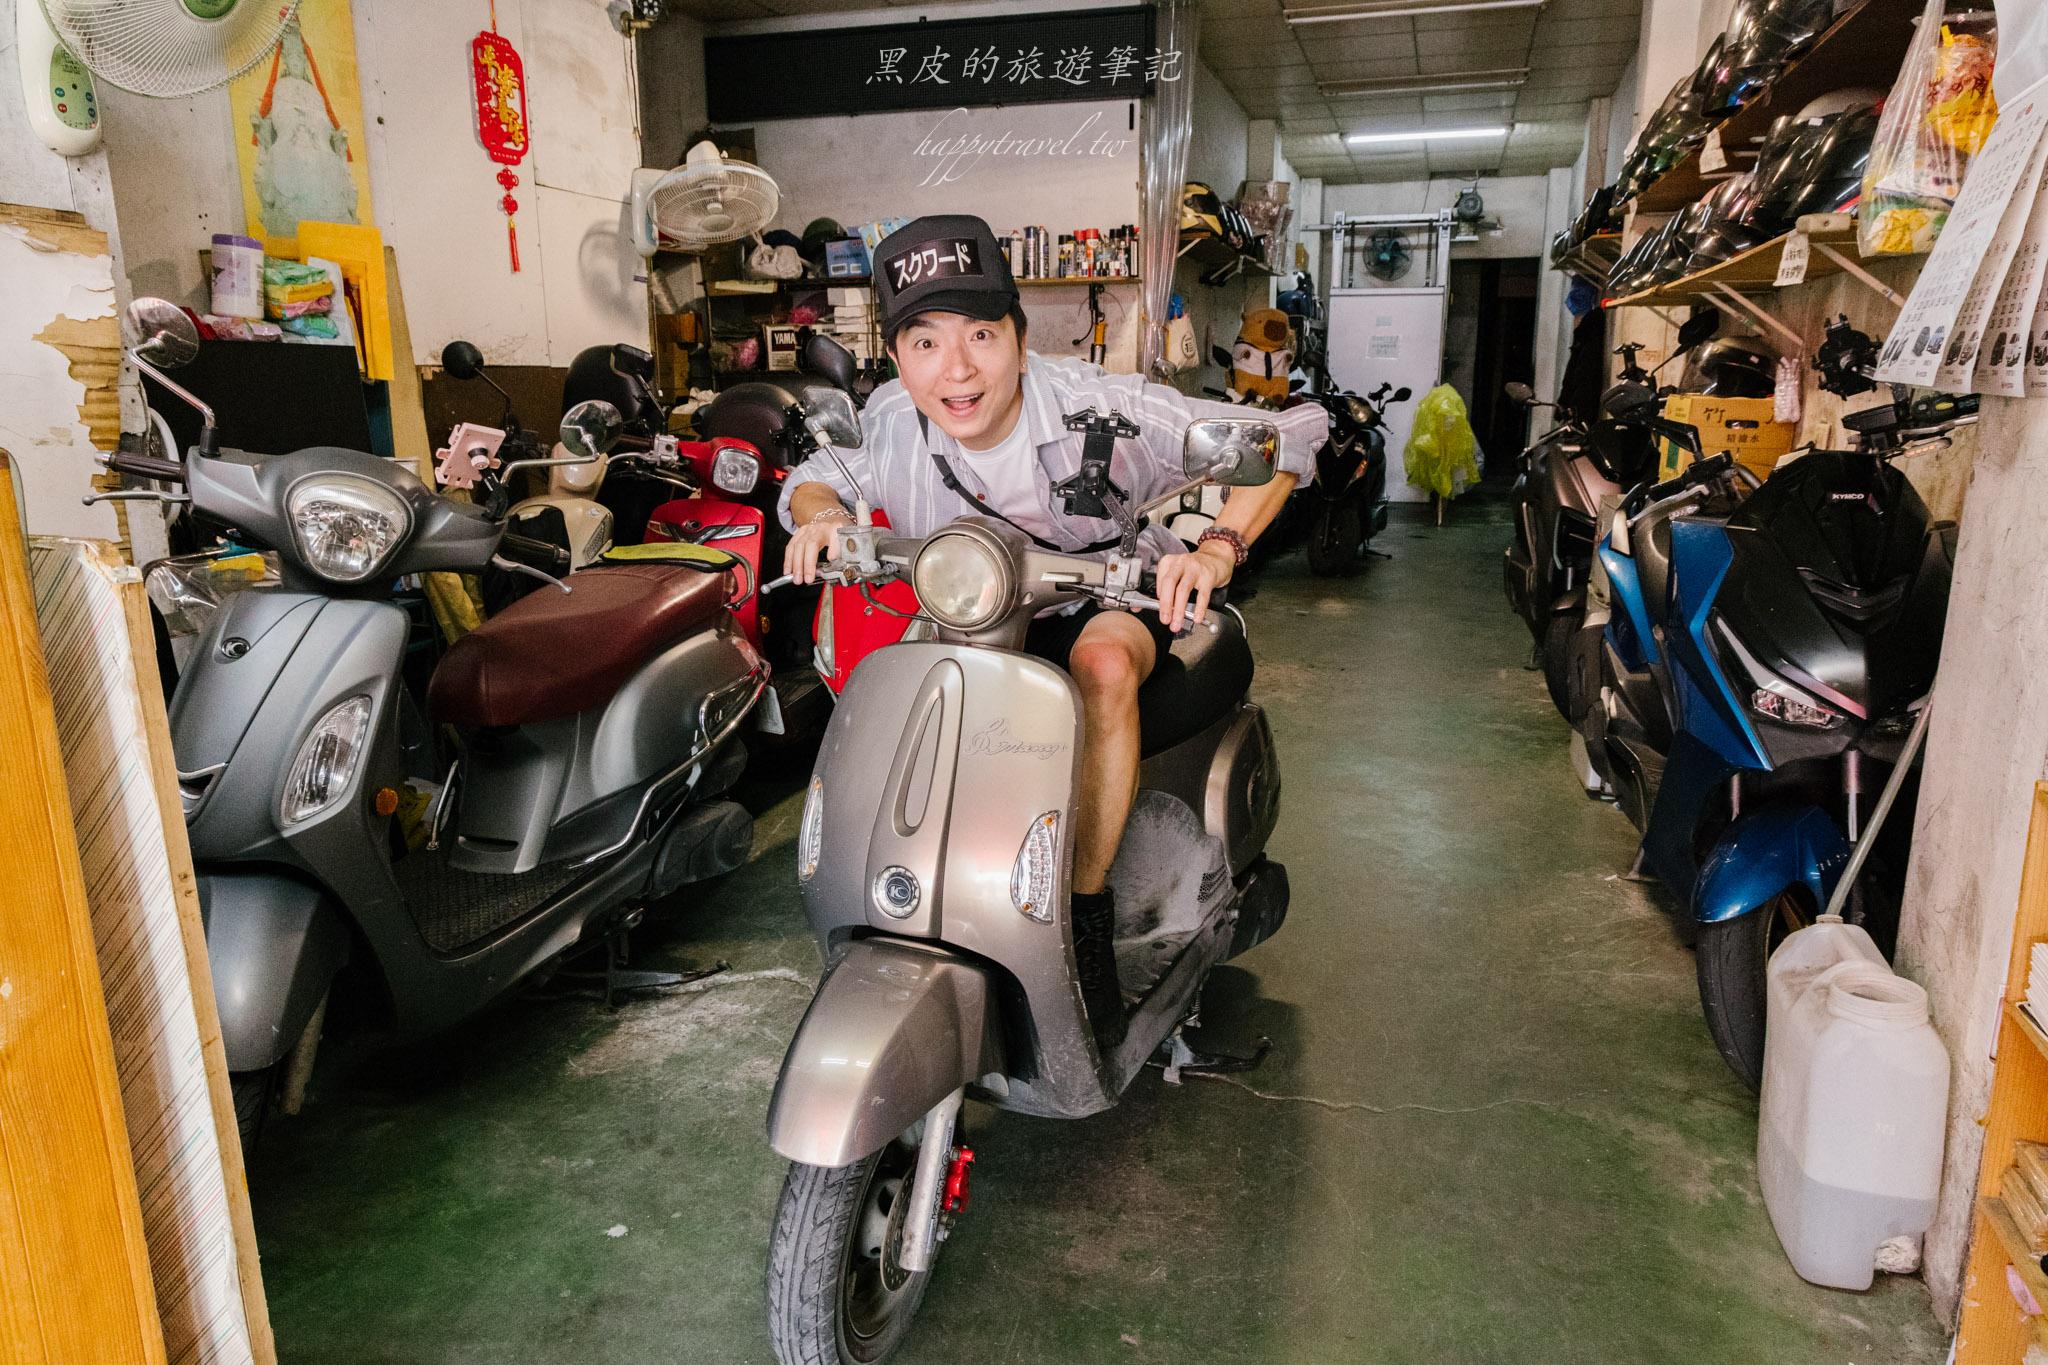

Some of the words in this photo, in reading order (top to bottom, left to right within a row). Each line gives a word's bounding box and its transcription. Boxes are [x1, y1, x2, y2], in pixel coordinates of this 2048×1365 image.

[894, 242, 971, 289] スクワード
[774, 332, 797, 345] YAMA
